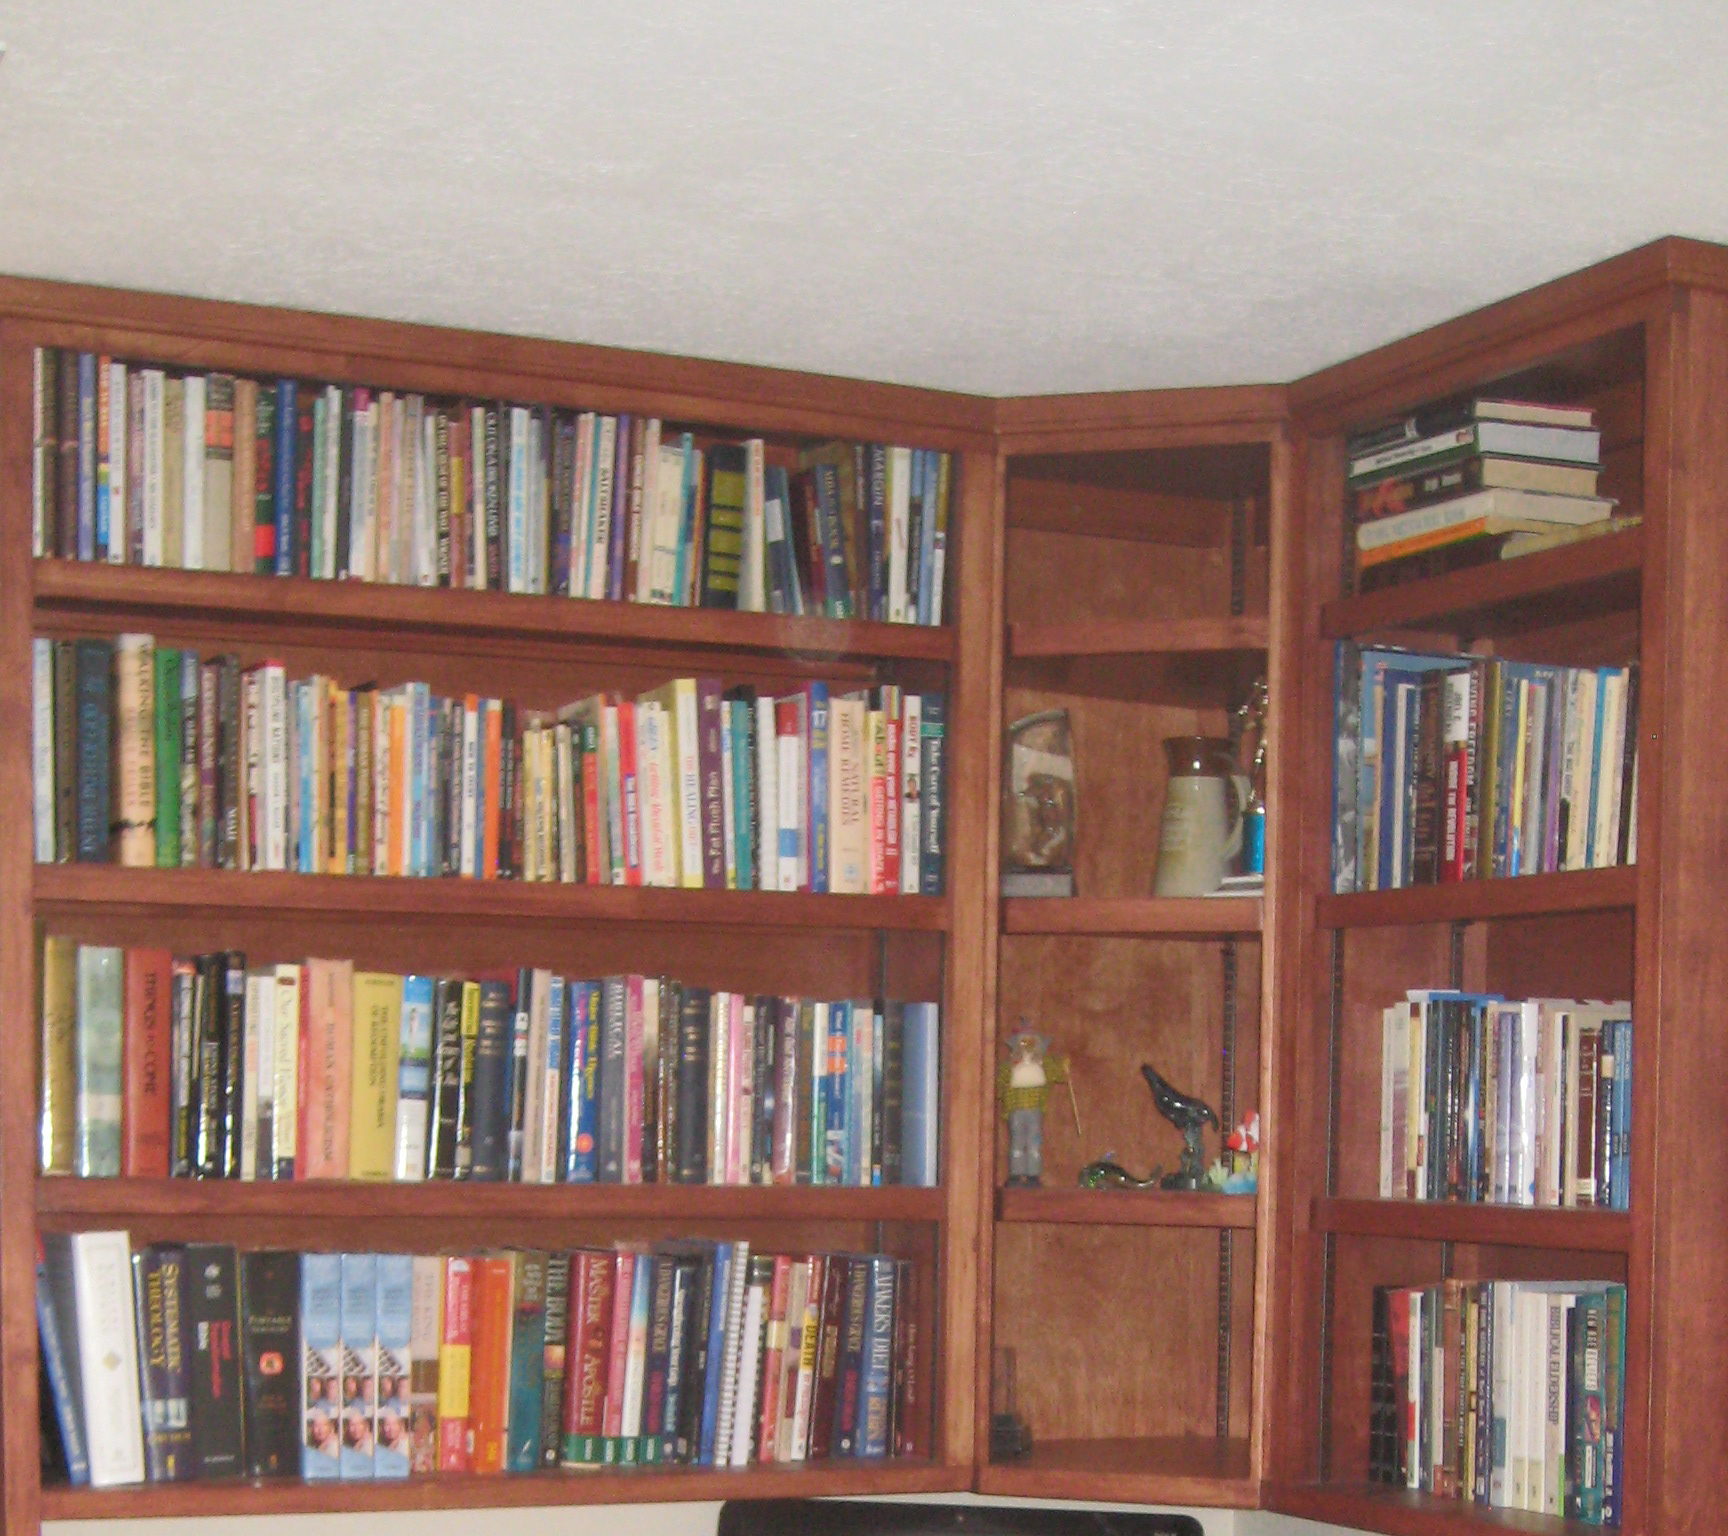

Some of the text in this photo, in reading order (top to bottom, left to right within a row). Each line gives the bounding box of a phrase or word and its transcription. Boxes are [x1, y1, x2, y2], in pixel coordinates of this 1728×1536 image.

[138, 643, 152, 807] WALKING THE BIBLE
[1467, 671, 1479, 785] SAVING FREEDOM
[685, 773, 698, 825] HEALING
[839, 713, 851, 826] HOME REMEDIES
[850, 762, 860, 823] NATURAL
[928, 740, 941, 854] Take Care of Yourself
[1446, 808, 1457, 861] REVOLUTION
[144, 972, 157, 1029] THINGS
[613, 984, 625, 1055] BIBLICAL
[144, 1050, 157, 1095] COME
[148, 1271, 167, 1368] THEOLOGY
[162, 1263, 181, 1372] SYSTEMATIC
[585, 1257, 609, 1325] MASTER
[803, 1324, 817, 1368] DEATH
[1548, 1305, 1562, 1425] BIBLICAL ELDERSHIP
[1585, 1308, 1599, 1391] NEW AGE BELIEFS
[580, 1353, 604, 1426] APOSTLE
